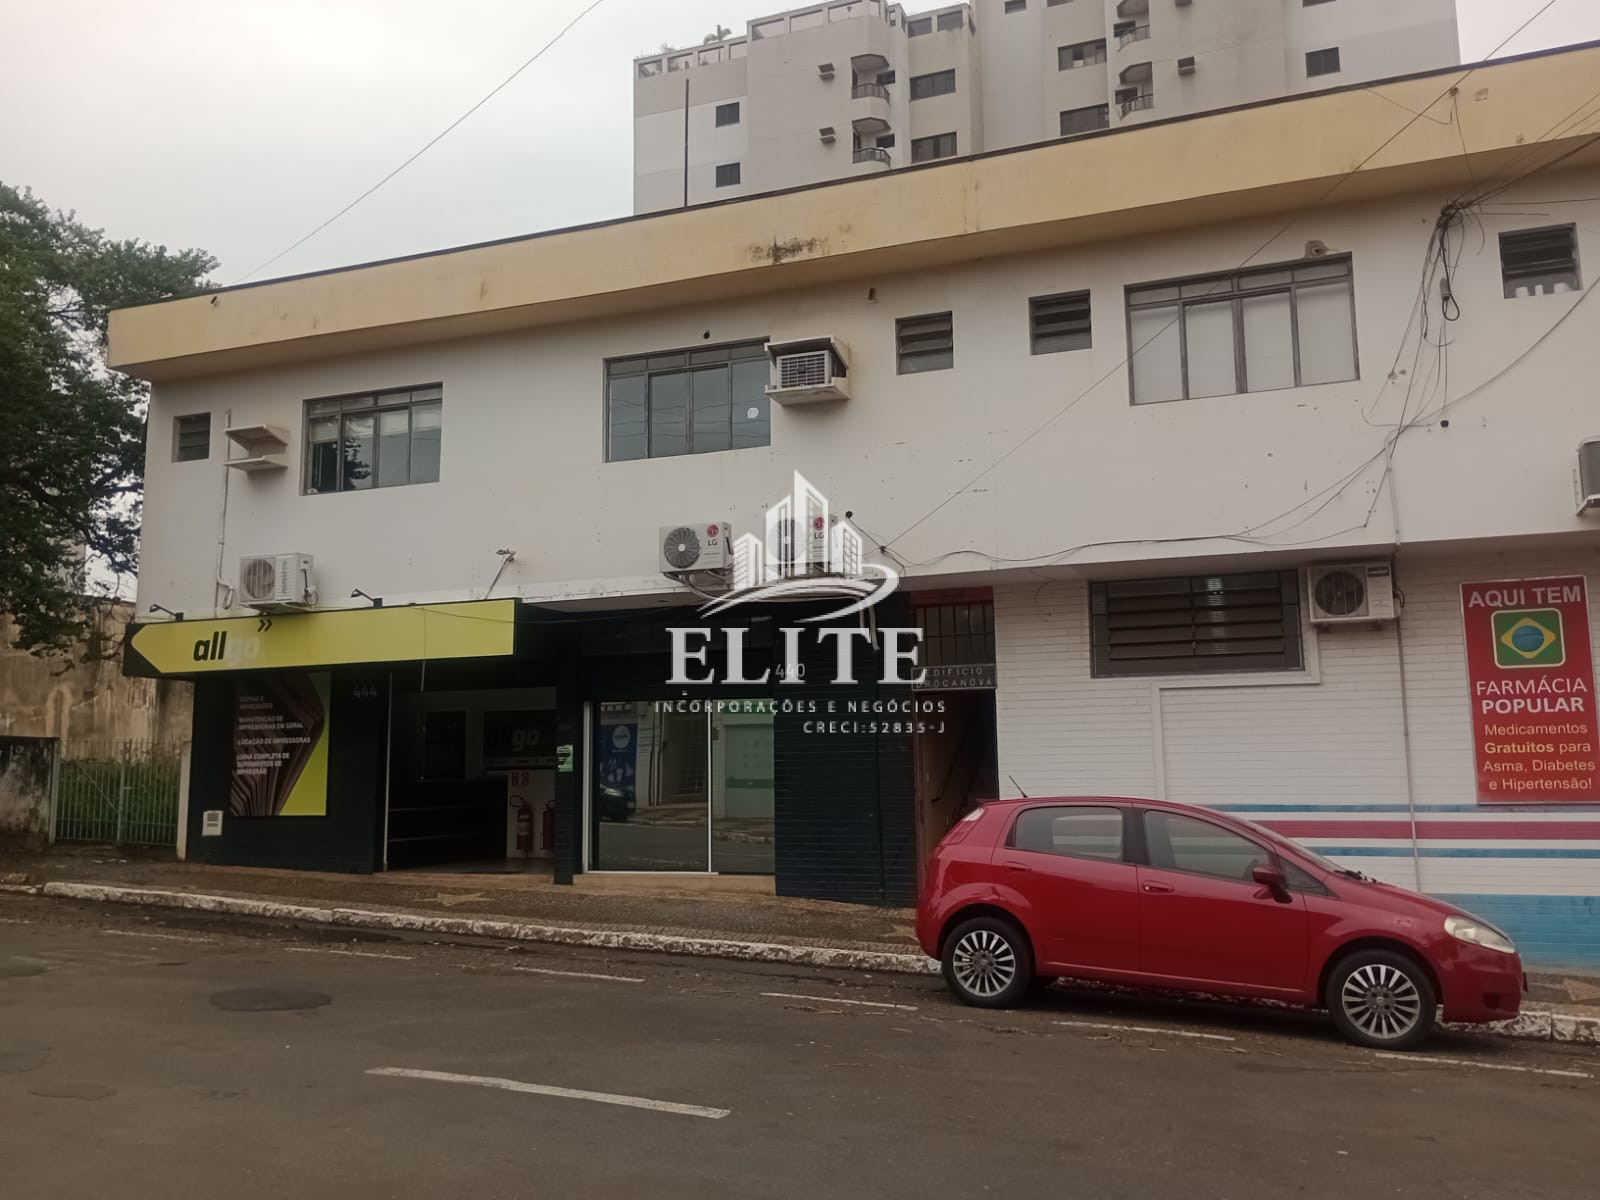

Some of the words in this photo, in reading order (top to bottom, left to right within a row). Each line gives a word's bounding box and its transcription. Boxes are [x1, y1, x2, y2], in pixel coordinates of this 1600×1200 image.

[1468, 588, 1525, 608] AQUI
[1531, 585, 1581, 604] TEM
[353, 684, 377, 698] 444
[1476, 675, 1588, 696] FARMÁCIA
[1481, 697, 1585, 715] POPULAR
[1484, 723, 1588, 736] Medicamentos
[1484, 742, 1554, 753] Gratuitos
[1559, 742, 1591, 755] para
[1483, 760, 1528, 773] Asma,
[1532, 759, 1596, 772] Diabetes
[1488, 780, 1497, 790] e
[1502, 777, 1592, 792] Hipertensão!
